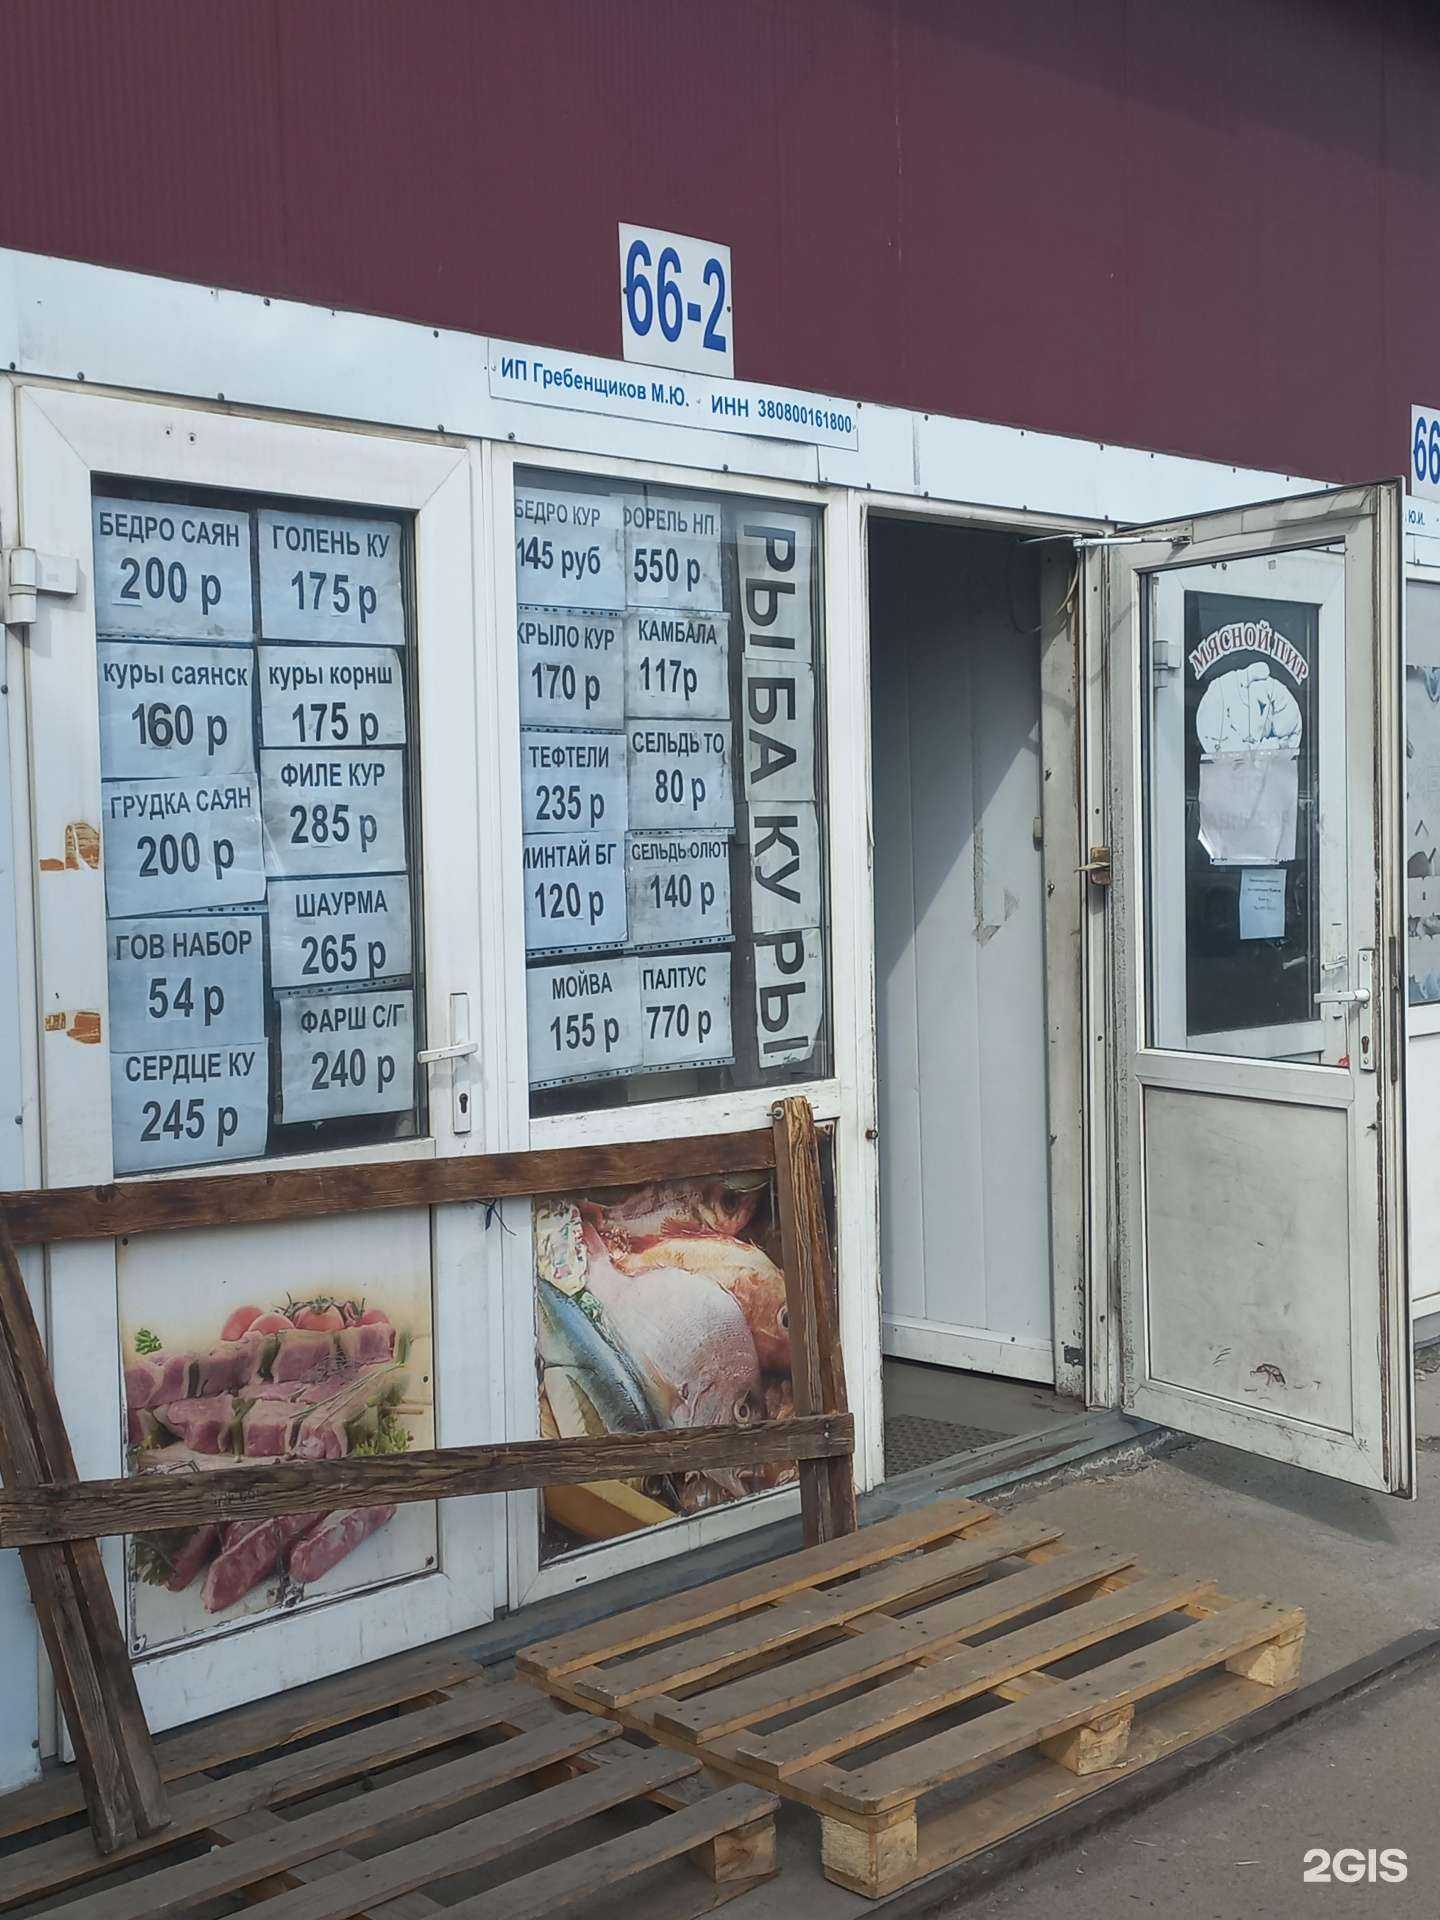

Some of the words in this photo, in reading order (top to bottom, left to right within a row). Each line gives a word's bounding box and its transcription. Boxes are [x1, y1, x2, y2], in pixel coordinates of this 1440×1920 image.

[626, 239, 727, 353] 66-2
[501, 357, 527, 381] ИП
[533, 363, 647, 400] Гребенщиков
[651, 382, 690, 407] М.Ю.
[711, 394, 749, 417] ИНН
[758, 399, 851, 433] 380800161800
[1413, 416, 1440, 484] 66
[100, 512, 175, 543] БЕДРО
[181, 519, 239, 547] САЯН
[515, 499, 568, 525] БЕДРО
[573, 506, 600, 527] КУР
[693, 513, 714, 535] НП
[272, 524, 360, 556] ГОЛЕНЬ
[367, 534, 390, 558] КУ
[517, 537, 553, 569] 145
[561, 546, 600, 580] руб
[120, 557, 187, 603] 200
[201, 573, 221, 615] р
[634, 548, 679, 583] 550
[687, 557, 700, 592] р
[584, 627, 615, 650] КУР
[639, 619, 717, 645] КАМБАЛА
[1190, 620, 1272, 678] МЯСНОЙ
[1272, 632, 1309, 682] ПИР
[104, 663, 164, 689] куры
[171, 664, 248, 686] саянск
[744, 525, 797, 785] РЫБА
[269, 666, 323, 690] куры
[330, 665, 393, 691] корнш
[531, 663, 576, 700] 170
[585, 674, 600, 710] р
[132, 702, 193, 747] 160
[207, 715, 228, 755] р
[291, 702, 348, 743] 175
[359, 711, 378, 744] р
[529, 746, 609, 769] ТЕФТЕЛИ
[632, 732, 699, 757] СЕЛЬДЬ
[703, 733, 724, 754] ТО
[281, 763, 341, 787] ФИЛЕ
[349, 763, 385, 787] КУР
[655, 769, 684, 803] 80
[692, 777, 706, 811] р
[110, 792, 191, 820] ГРУДКА
[197, 786, 251, 811] САЯН
[536, 785, 582, 820] 235
[590, 793, 604, 828] р
[289, 804, 350, 844] 285
[359, 813, 378, 852] р
[137, 832, 200, 877] 200
[213, 838, 235, 880] р
[596, 843, 617, 865] БГ
[296, 890, 388, 918] ШАУРМА
[534, 882, 581, 919] 120
[589, 890, 604, 926] р
[650, 873, 692, 909] 140
[700, 880, 715, 915] р
[116, 934, 164, 960] ГОВ
[173, 930, 252, 958] НАБОР
[753, 815, 809, 1055] КУРЫ
[301, 934, 357, 975] 265
[368, 941, 386, 980] р
[552, 969, 613, 1000] МОЙВА
[642, 966, 707, 991] ПАЛТУС
[149, 977, 194, 1019] 54
[204, 984, 225, 1026] р
[301, 1006, 366, 1033] ФАРШ
[373, 1003, 405, 1028] С/Г
[550, 1012, 595, 1051] 155
[604, 1015, 620, 1053] р
[645, 1003, 689, 1040] 770
[698, 1008, 712, 1043] р
[125, 1053, 222, 1084] СЕРДЦЕ
[228, 1051, 255, 1077] КУ
[312, 1049, 366, 1090] 240
[377, 1055, 395, 1093] р
[140, 1099, 205, 1142] 245
[217, 1105, 239, 1147] р
